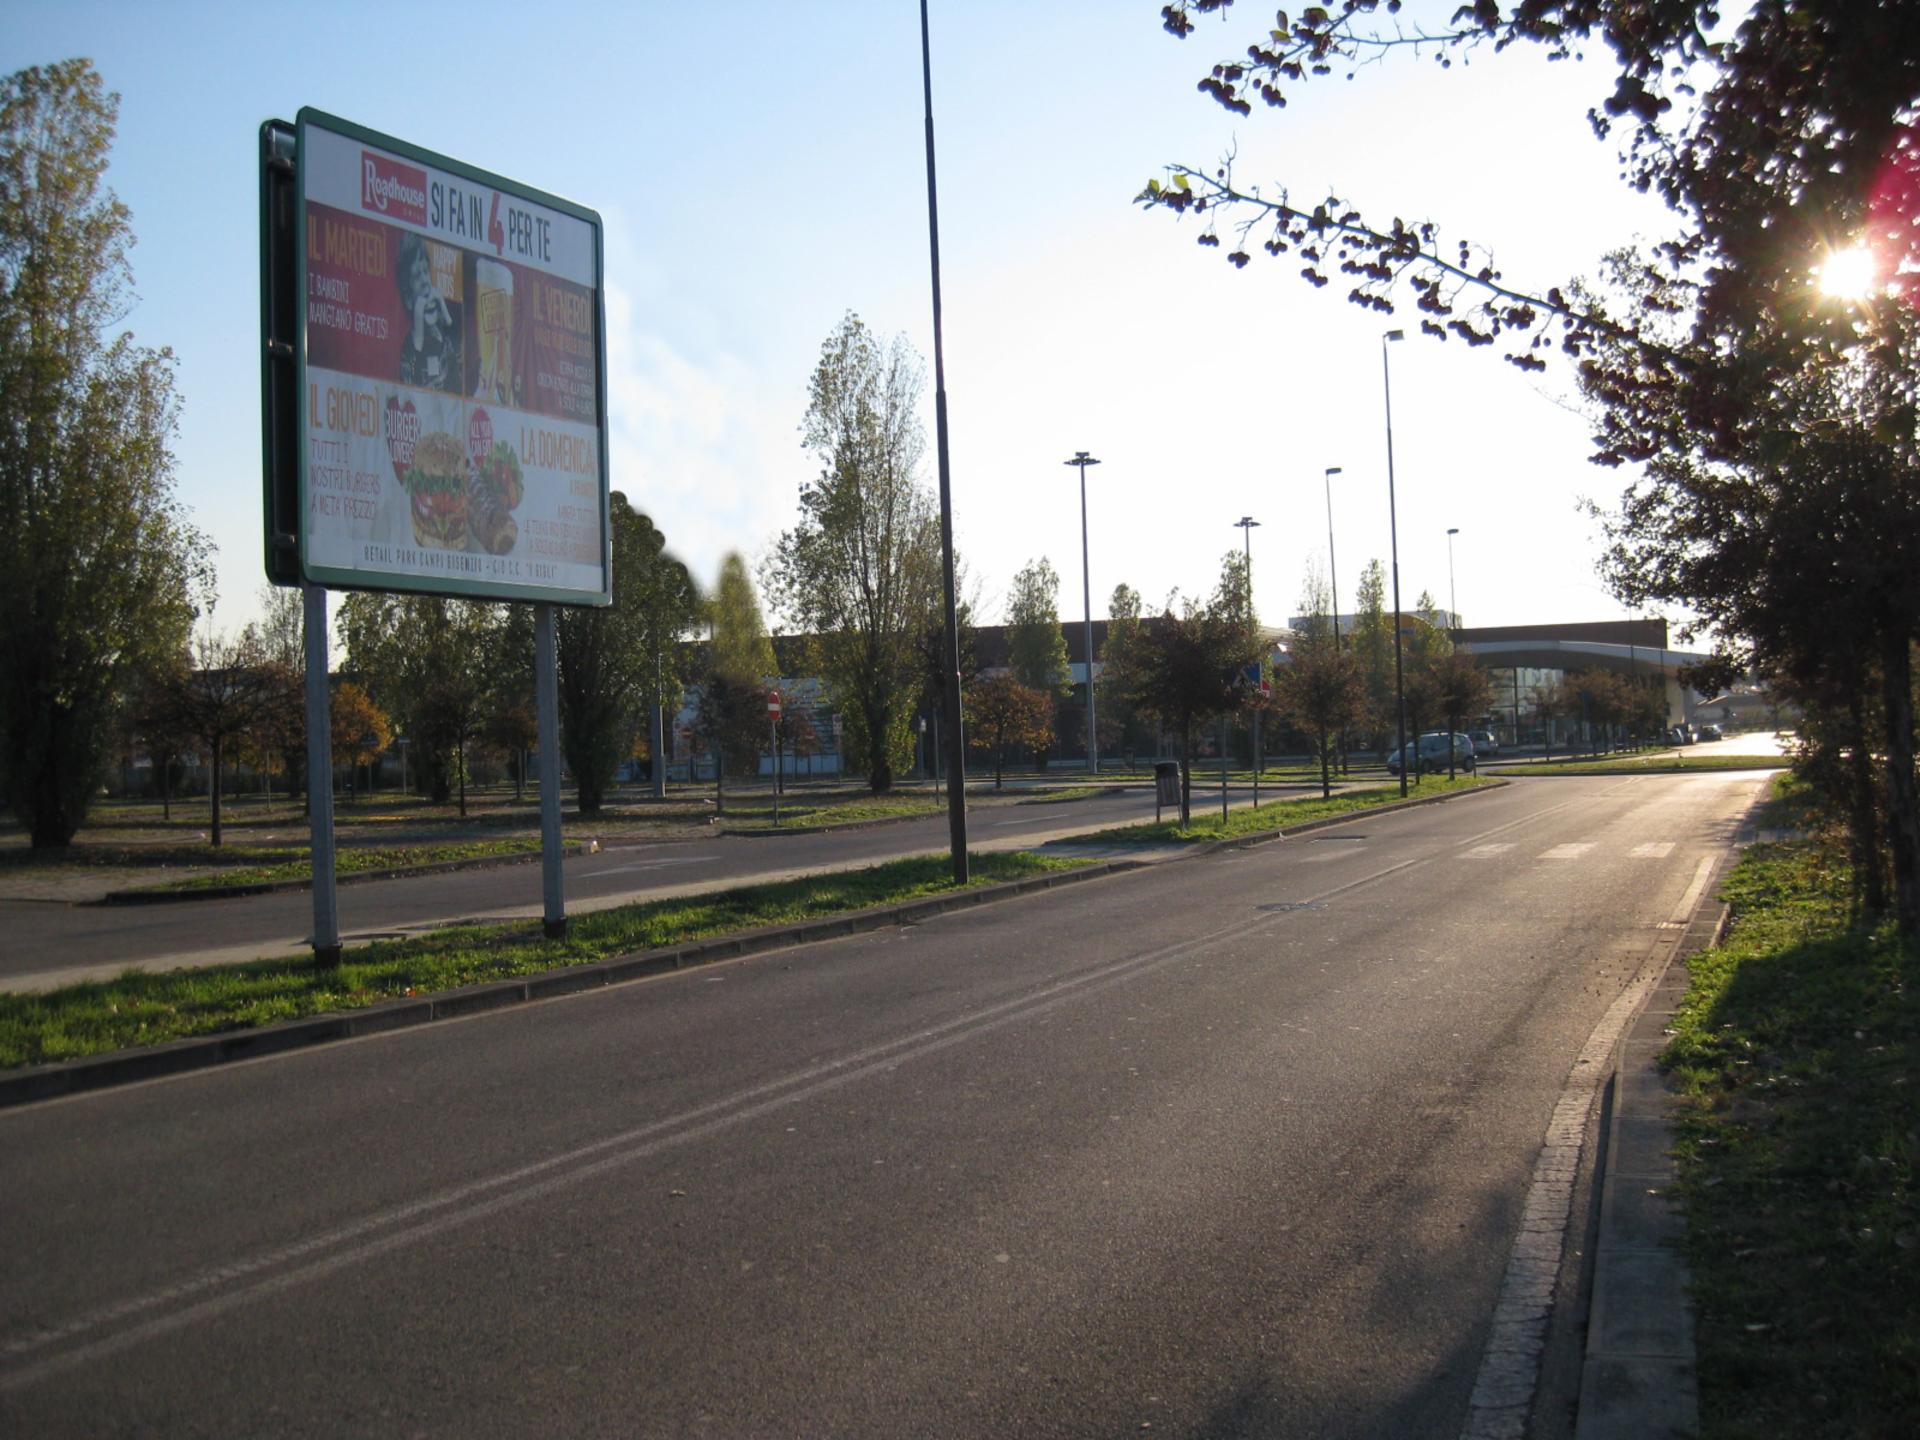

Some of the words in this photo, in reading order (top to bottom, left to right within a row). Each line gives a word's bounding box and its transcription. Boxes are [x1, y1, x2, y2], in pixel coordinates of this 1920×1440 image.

[364, 159, 424, 210] Roadhouse
[432, 181, 444, 229] SI
[449, 188, 465, 236] FA
[470, 194, 482, 242] IN
[489, 192, 504, 256] 4
[509, 208, 533, 257] PER
[536, 217, 551, 263] TE
[308, 215, 321, 262] IL
[326, 220, 386, 279] MARTEDÌ
[310, 302, 352, 332] MANGIANO
[310, 383, 322, 429] IL
[327, 387, 379, 438] GIOVEDÌ
[385, 409, 420, 443] BURGER
[521, 426, 536, 466] LA
[311, 466, 343, 490] NOSTRI
[364, 545, 392, 563] RETAIL
[397, 549, 416, 565] PARK
